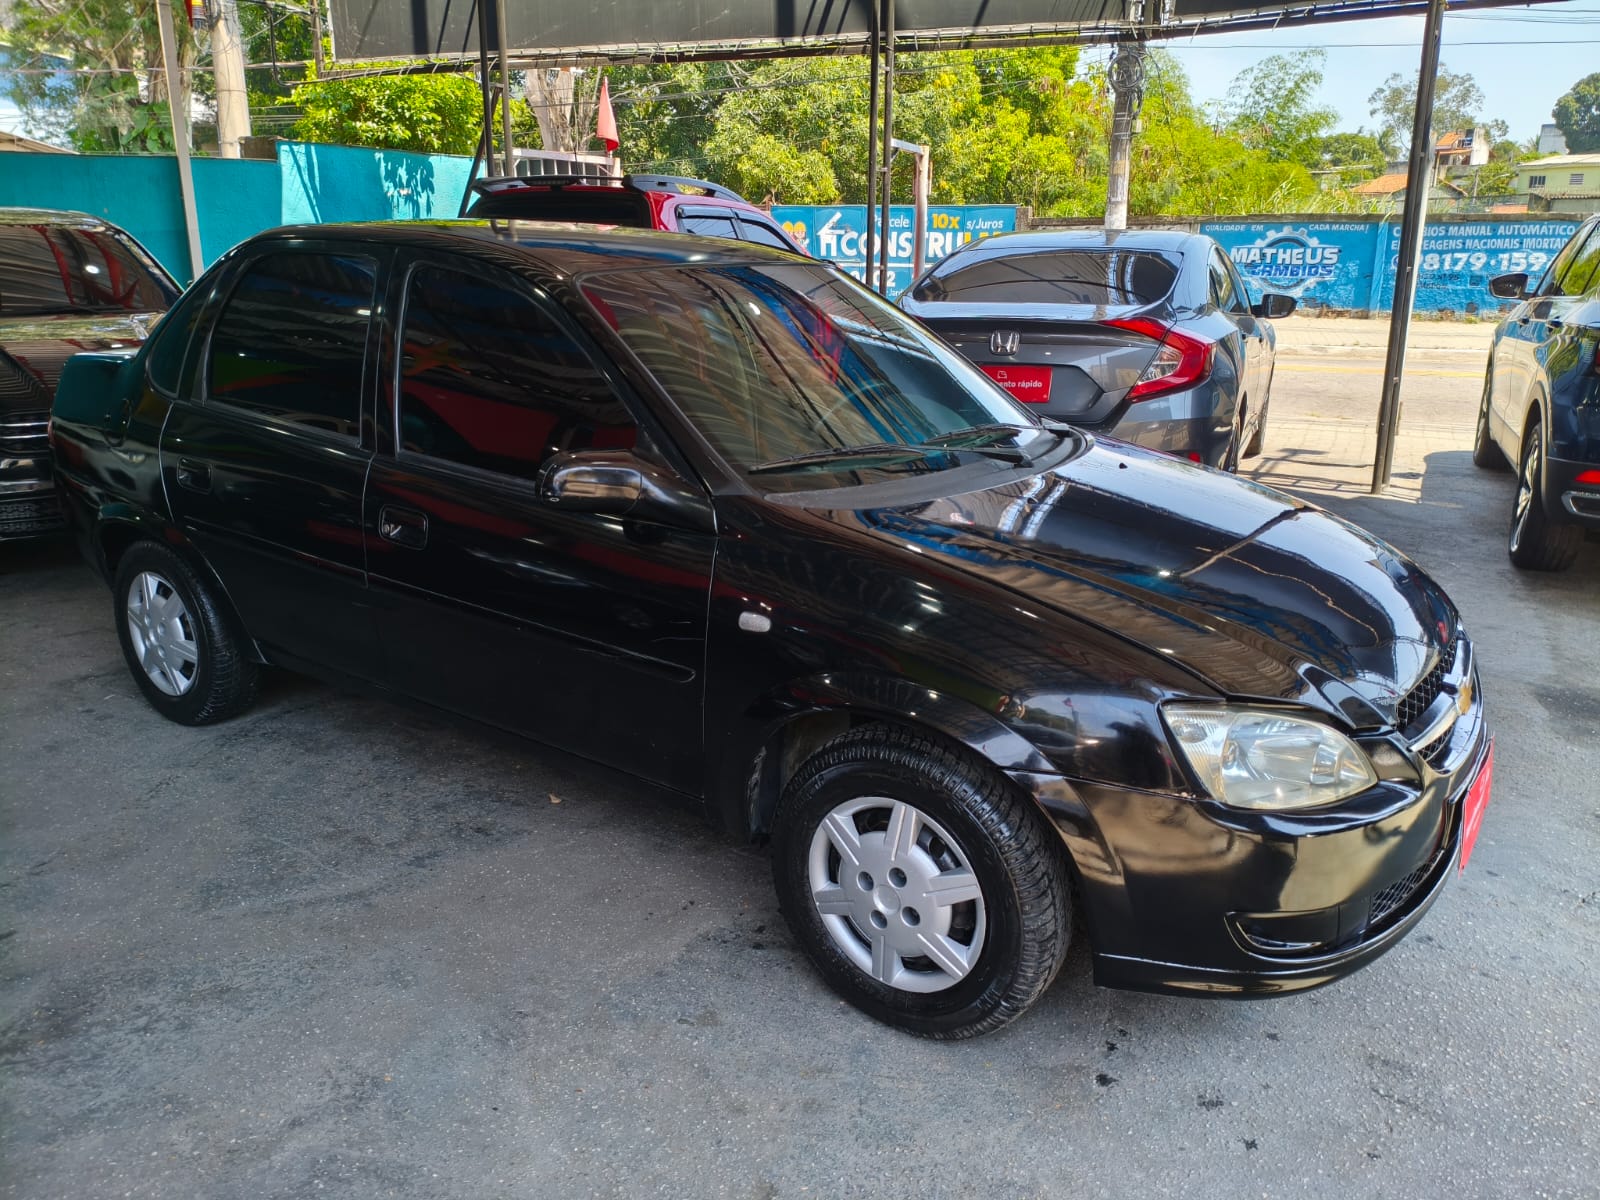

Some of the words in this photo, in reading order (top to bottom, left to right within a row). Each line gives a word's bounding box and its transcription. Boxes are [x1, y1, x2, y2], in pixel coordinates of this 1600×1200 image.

[1448, 226, 1492, 237] MANUAL
[1497, 222, 1576, 236] AUTOMÁTICO
[1465, 238, 1520, 250] NACIONAIS
[1231, 247, 1339, 265] MATHEUS
[1017, 379, 1043, 389] rápido
